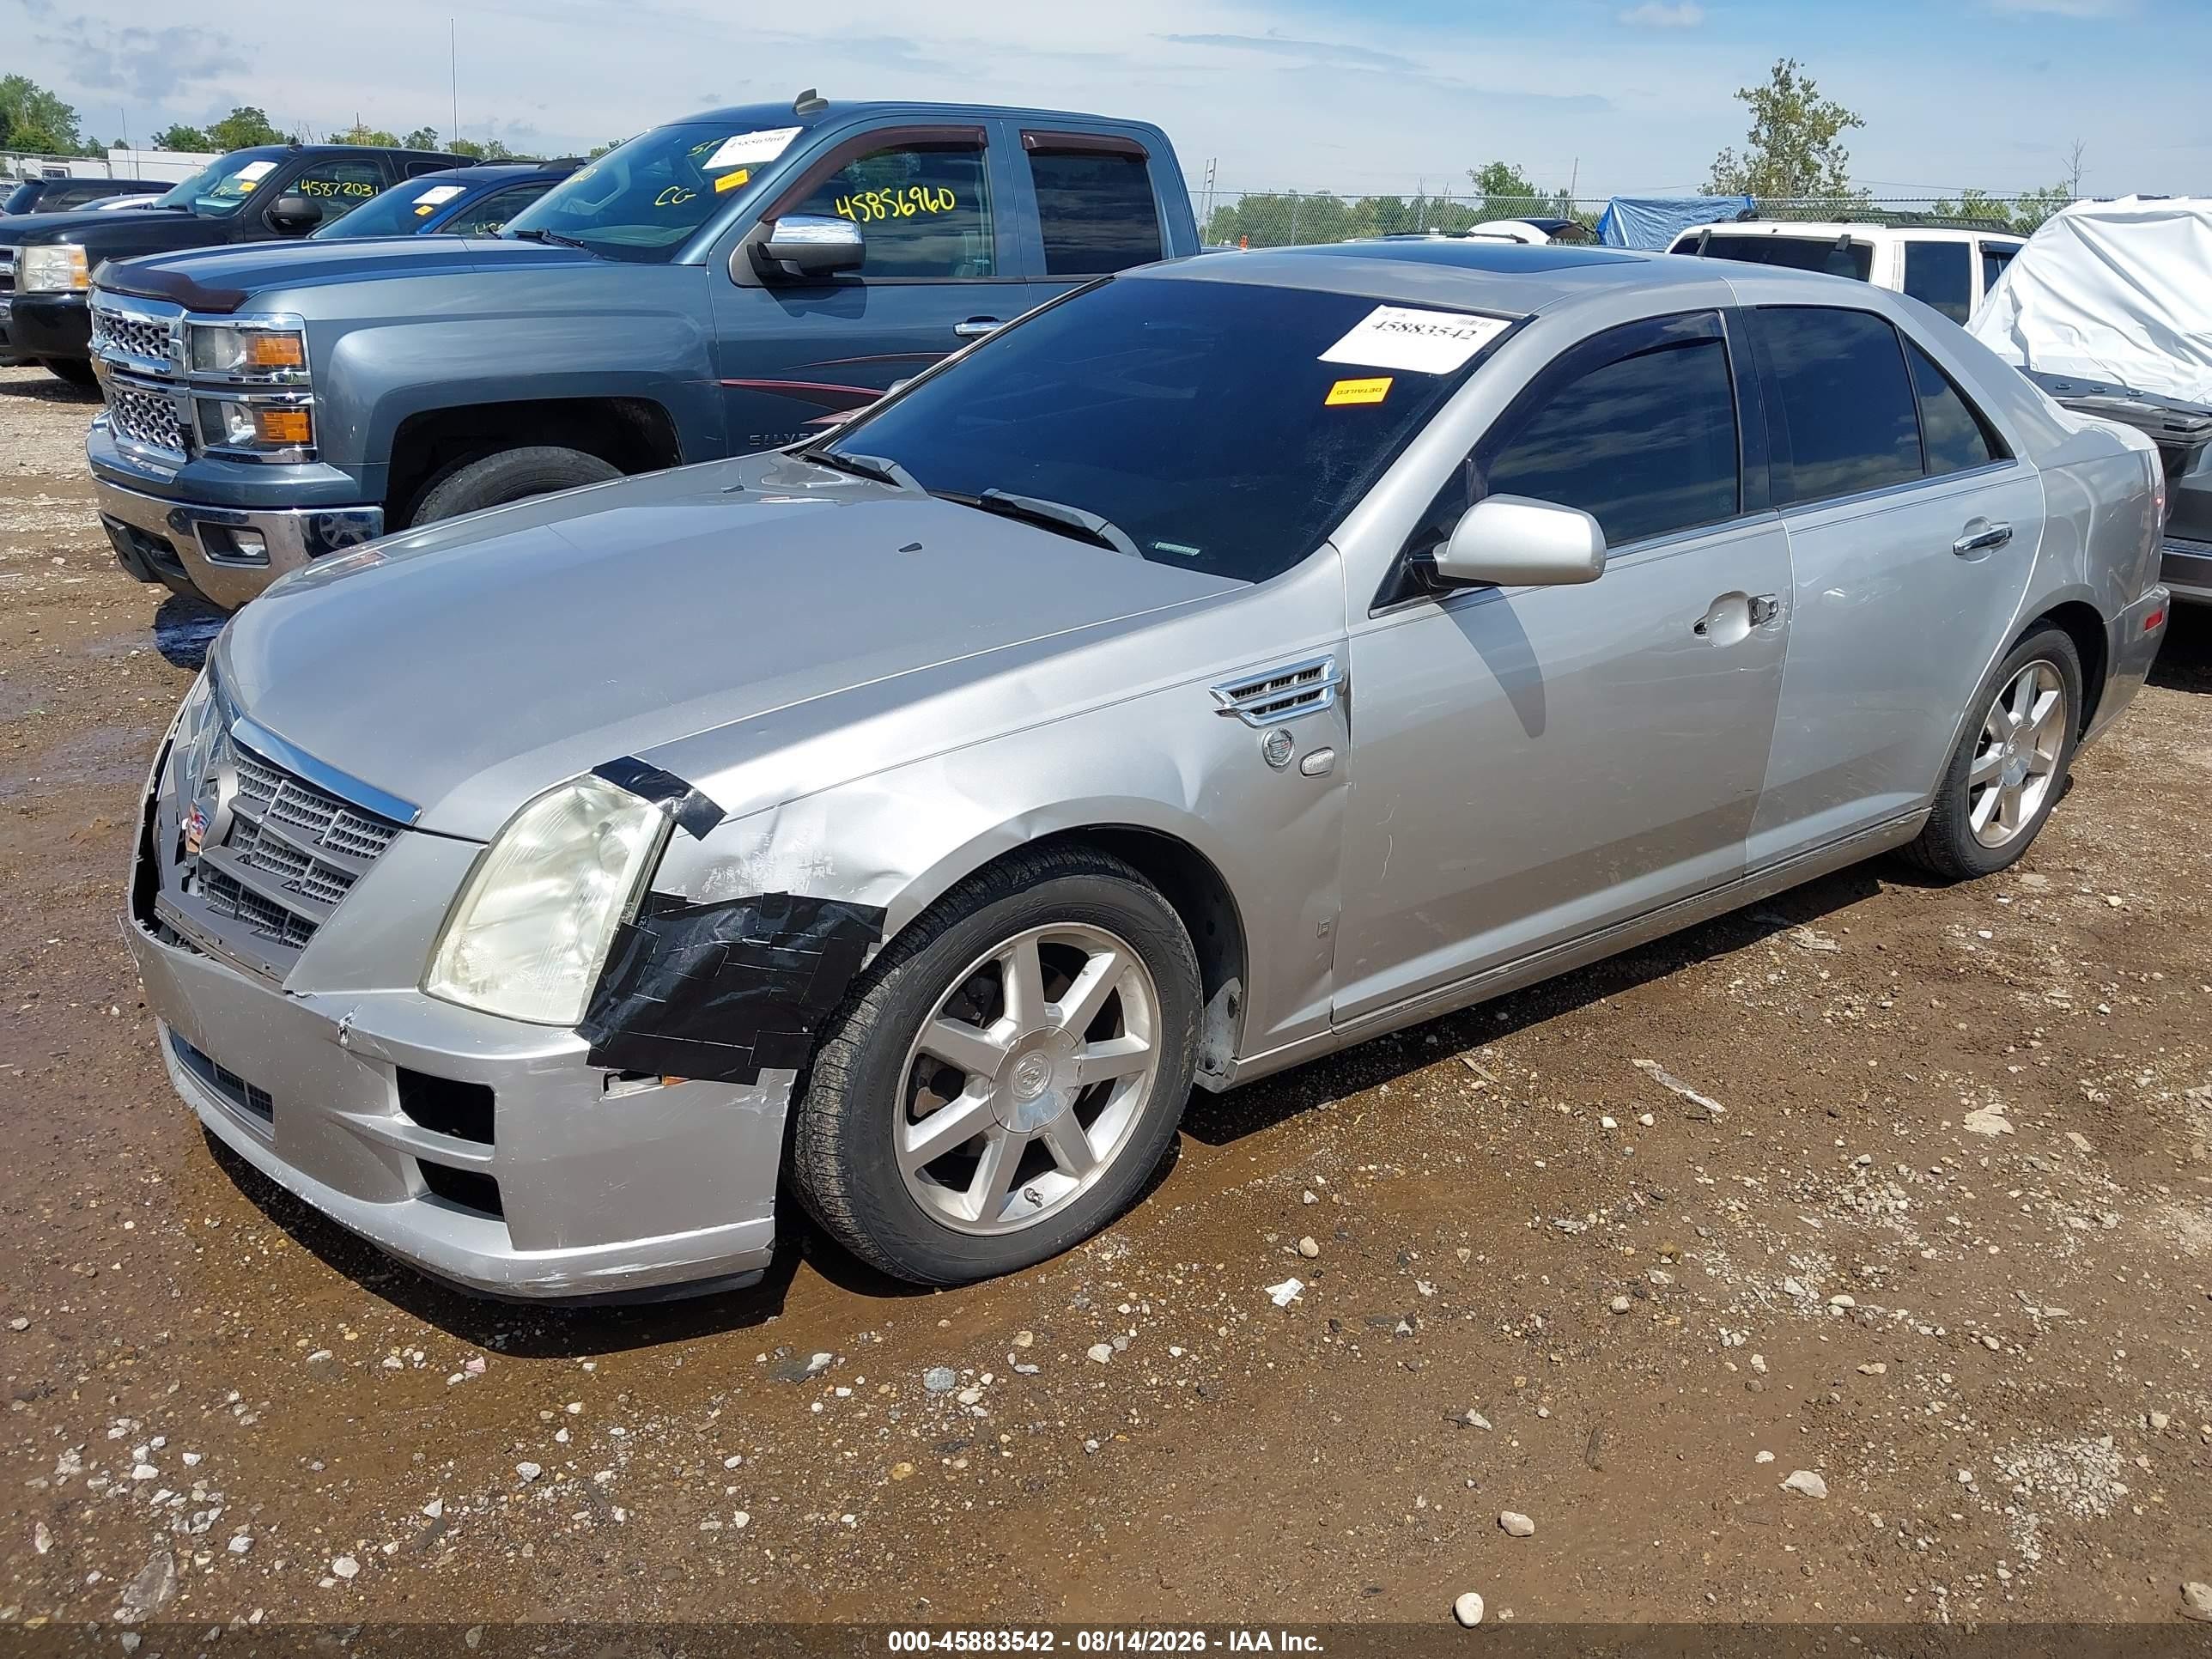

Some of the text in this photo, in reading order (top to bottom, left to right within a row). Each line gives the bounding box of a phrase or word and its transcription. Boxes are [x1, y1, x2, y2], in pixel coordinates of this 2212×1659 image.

[301, 179, 379, 197] 45872031
[654, 185, 696, 206] CG
[836, 186, 956, 222] 45856960
[1372, 320, 1478, 340] 45883542
[749, 433, 821, 446] SILVE
